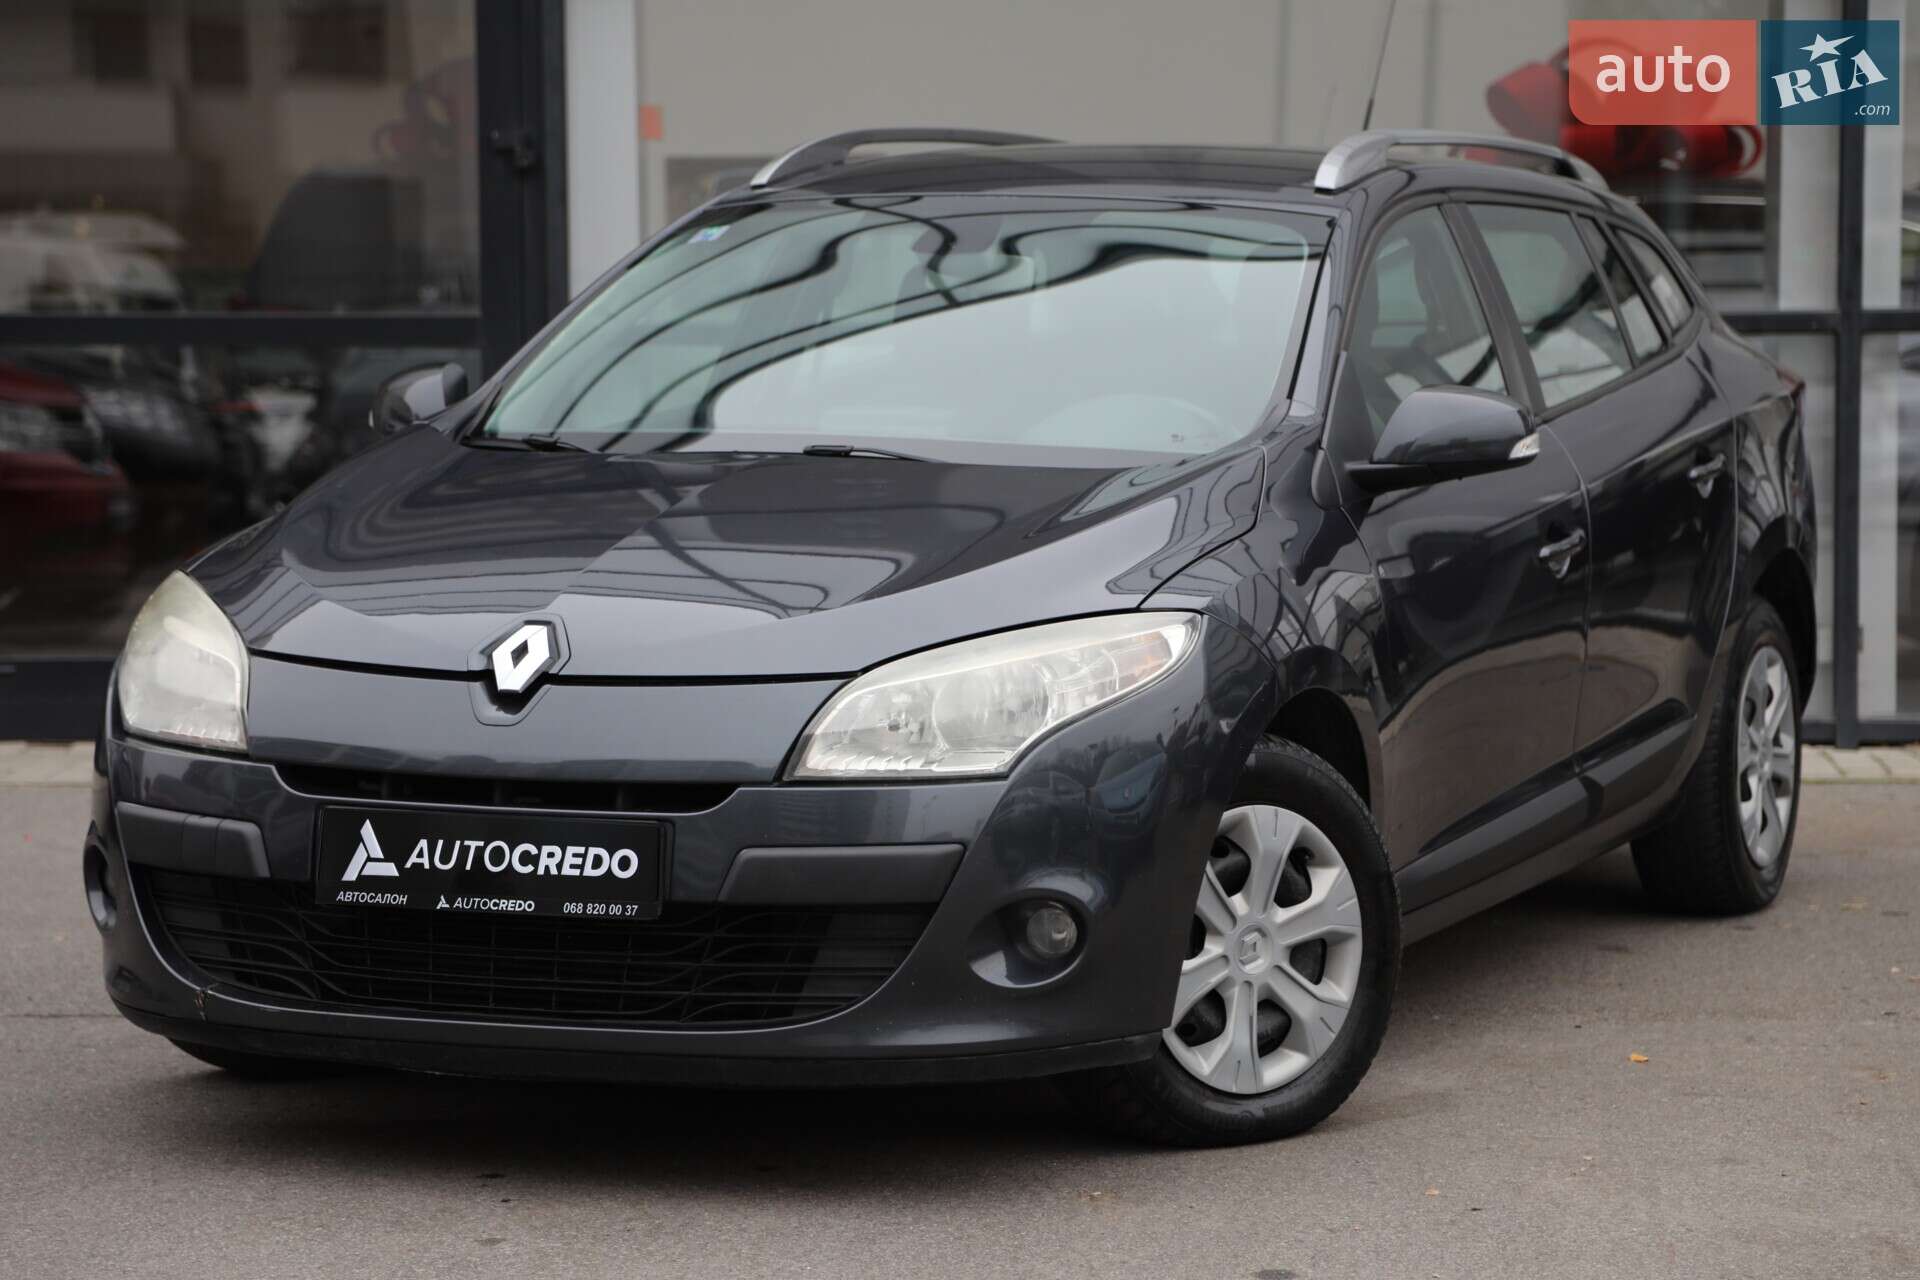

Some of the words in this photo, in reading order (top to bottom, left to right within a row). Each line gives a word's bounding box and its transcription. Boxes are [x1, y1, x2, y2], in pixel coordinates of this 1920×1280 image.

[404, 838, 639, 879] AUTOCREDO
[336, 890, 408, 905] АВТОСАЛОН
[453, 896, 535, 912] AUTOCREDO
[563, 902, 583, 914] 068
[586, 903, 606, 915] 820
[609, 904, 622, 916] 00
[625, 905, 638, 916] 37
